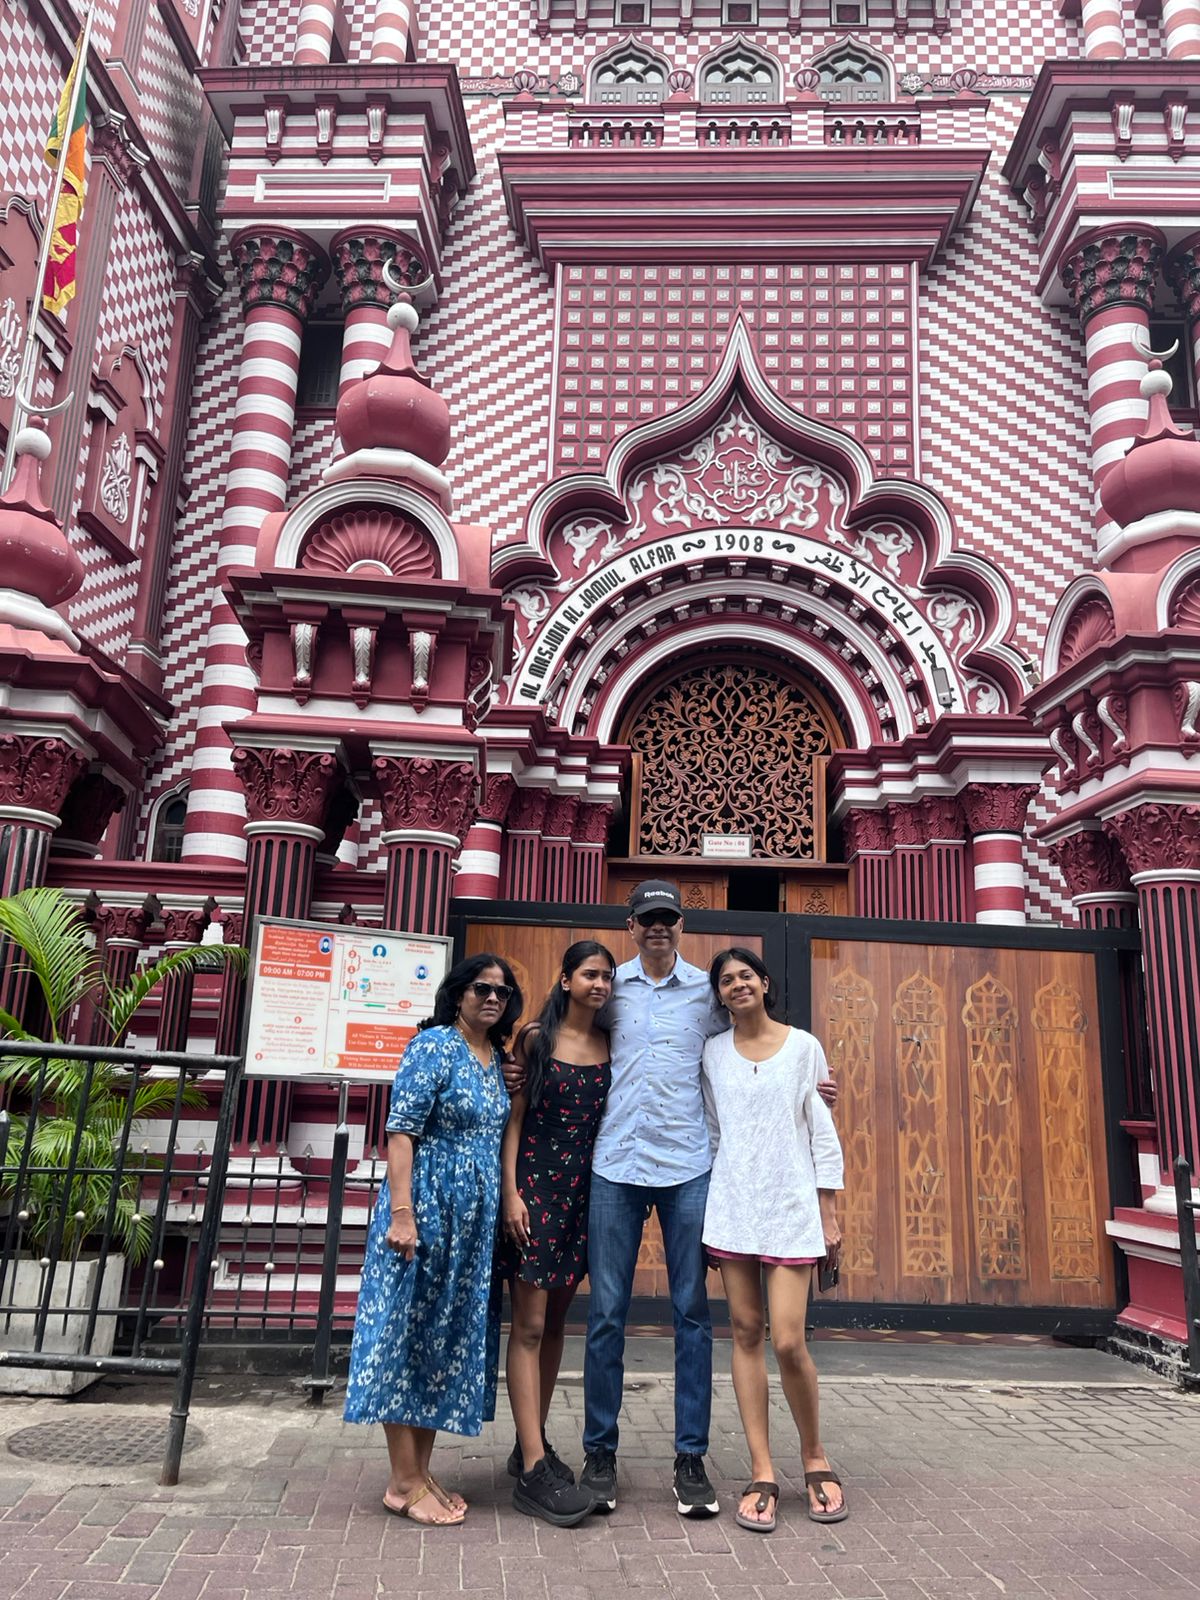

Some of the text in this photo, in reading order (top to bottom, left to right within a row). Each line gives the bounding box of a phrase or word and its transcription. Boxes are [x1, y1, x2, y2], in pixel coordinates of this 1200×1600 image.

[714, 533, 764, 553] 1908
[871, 586, 923, 636] الجامع
[520, 544, 677, 700] AL MASJIDH AL JAMIUL ALFAR
[644, 891, 675, 900] Reebok
[263, 966, 281, 974] 09:00
[282, 968, 293, 976] AM
[296, 969, 314, 978] 07:00
[315, 971, 325, 979] PM
